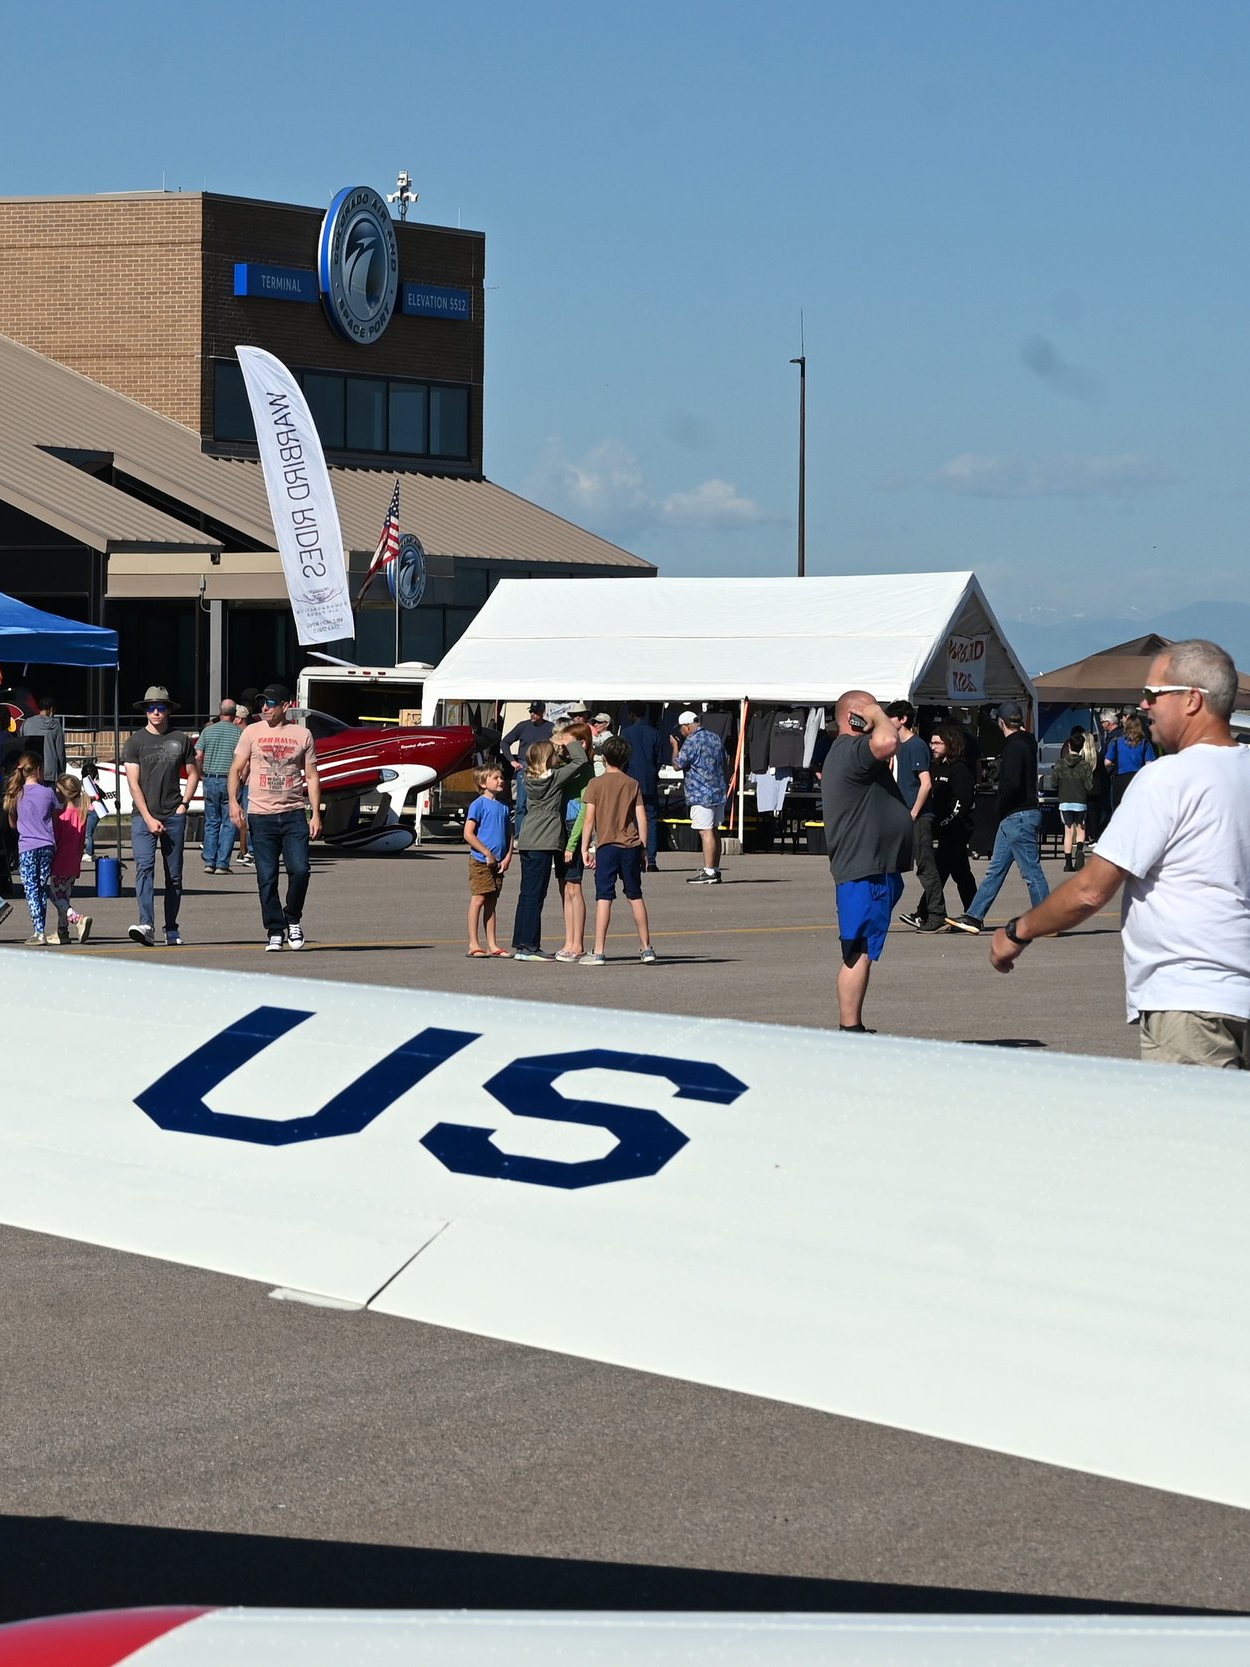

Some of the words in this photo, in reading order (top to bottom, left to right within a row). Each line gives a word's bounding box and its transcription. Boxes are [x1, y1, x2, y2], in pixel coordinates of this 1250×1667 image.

[334, 193, 369, 266] COLORADO
[372, 198, 388, 223] AIR
[386, 229, 397, 273] AND
[261, 275, 302, 292] TERMINAL
[408, 293, 448, 310] ELEVATION
[449, 298, 466, 312] 5512
[338, 297, 366, 338] SPACE
[368, 302, 390, 337] PORT
[133, 1005, 749, 1189] US
